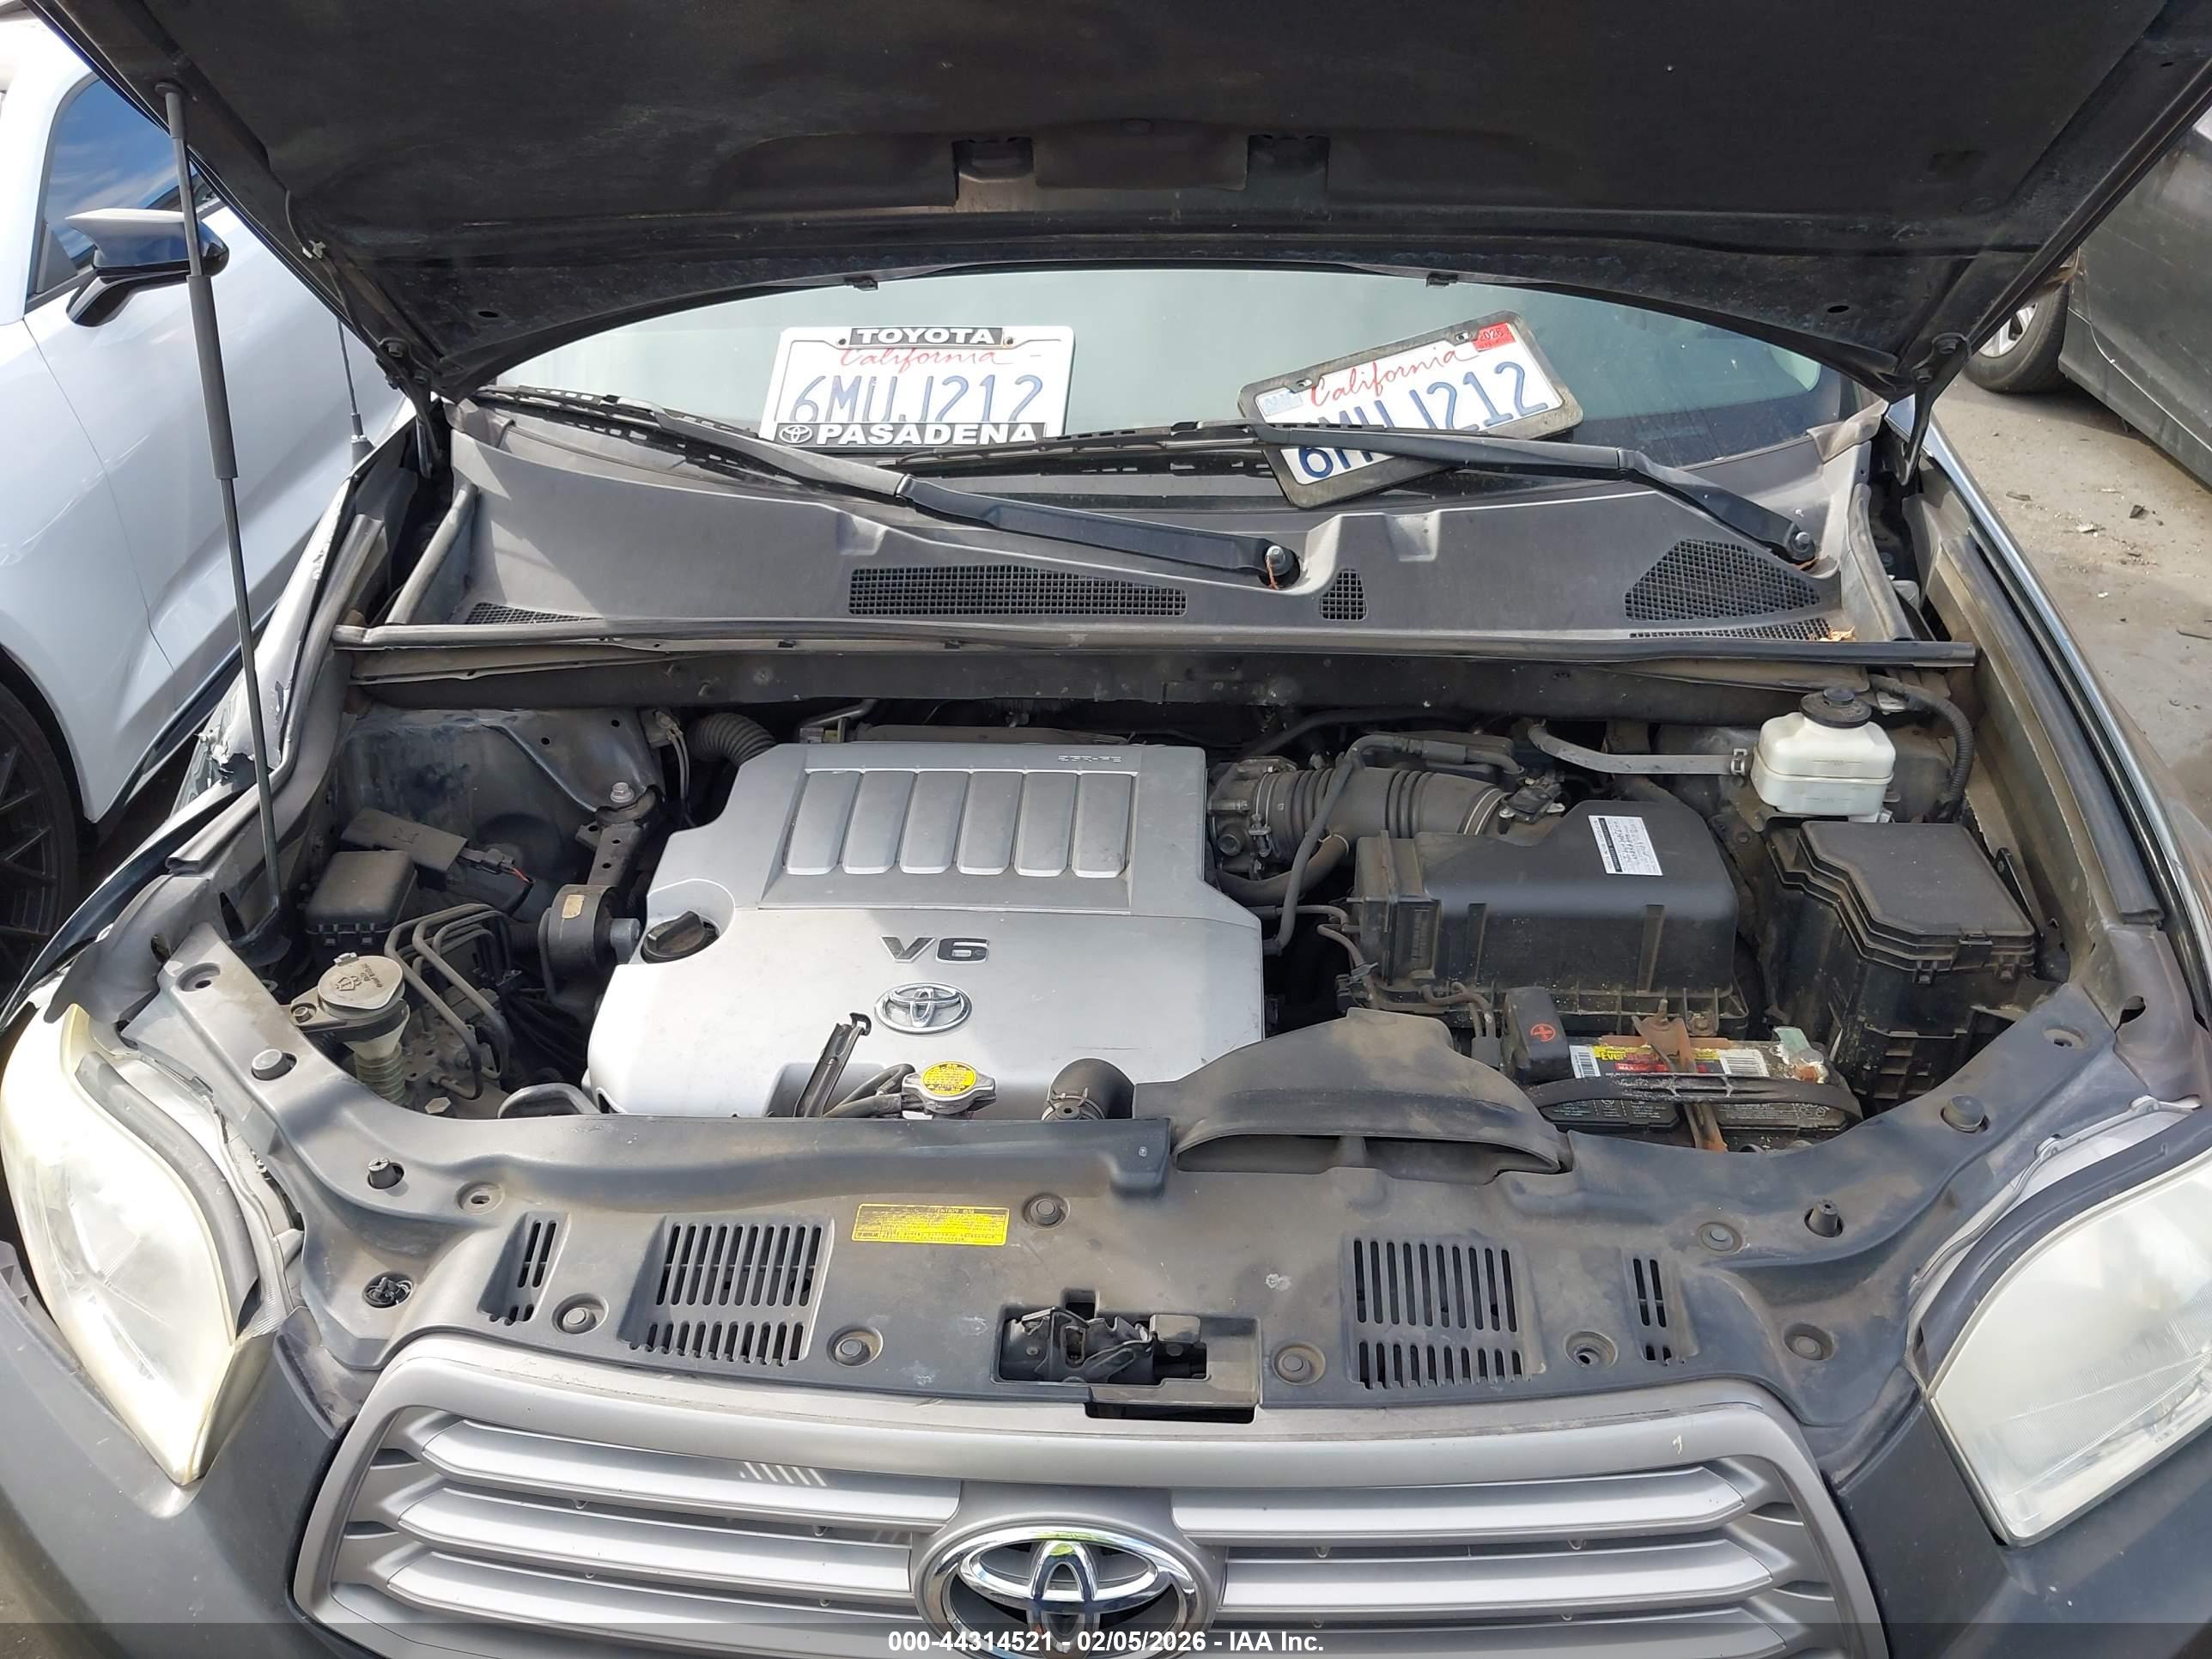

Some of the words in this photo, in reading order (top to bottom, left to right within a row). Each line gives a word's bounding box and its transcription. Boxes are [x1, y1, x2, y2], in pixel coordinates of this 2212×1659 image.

[856, 329, 994, 344] TOYOTA
[839, 348, 1014, 374] California
[1310, 346, 1479, 407] California
[788, 374, 1043, 422] 6MUJ212
[816, 423, 1038, 446] PASADENA
[879, 936, 990, 964] V6
